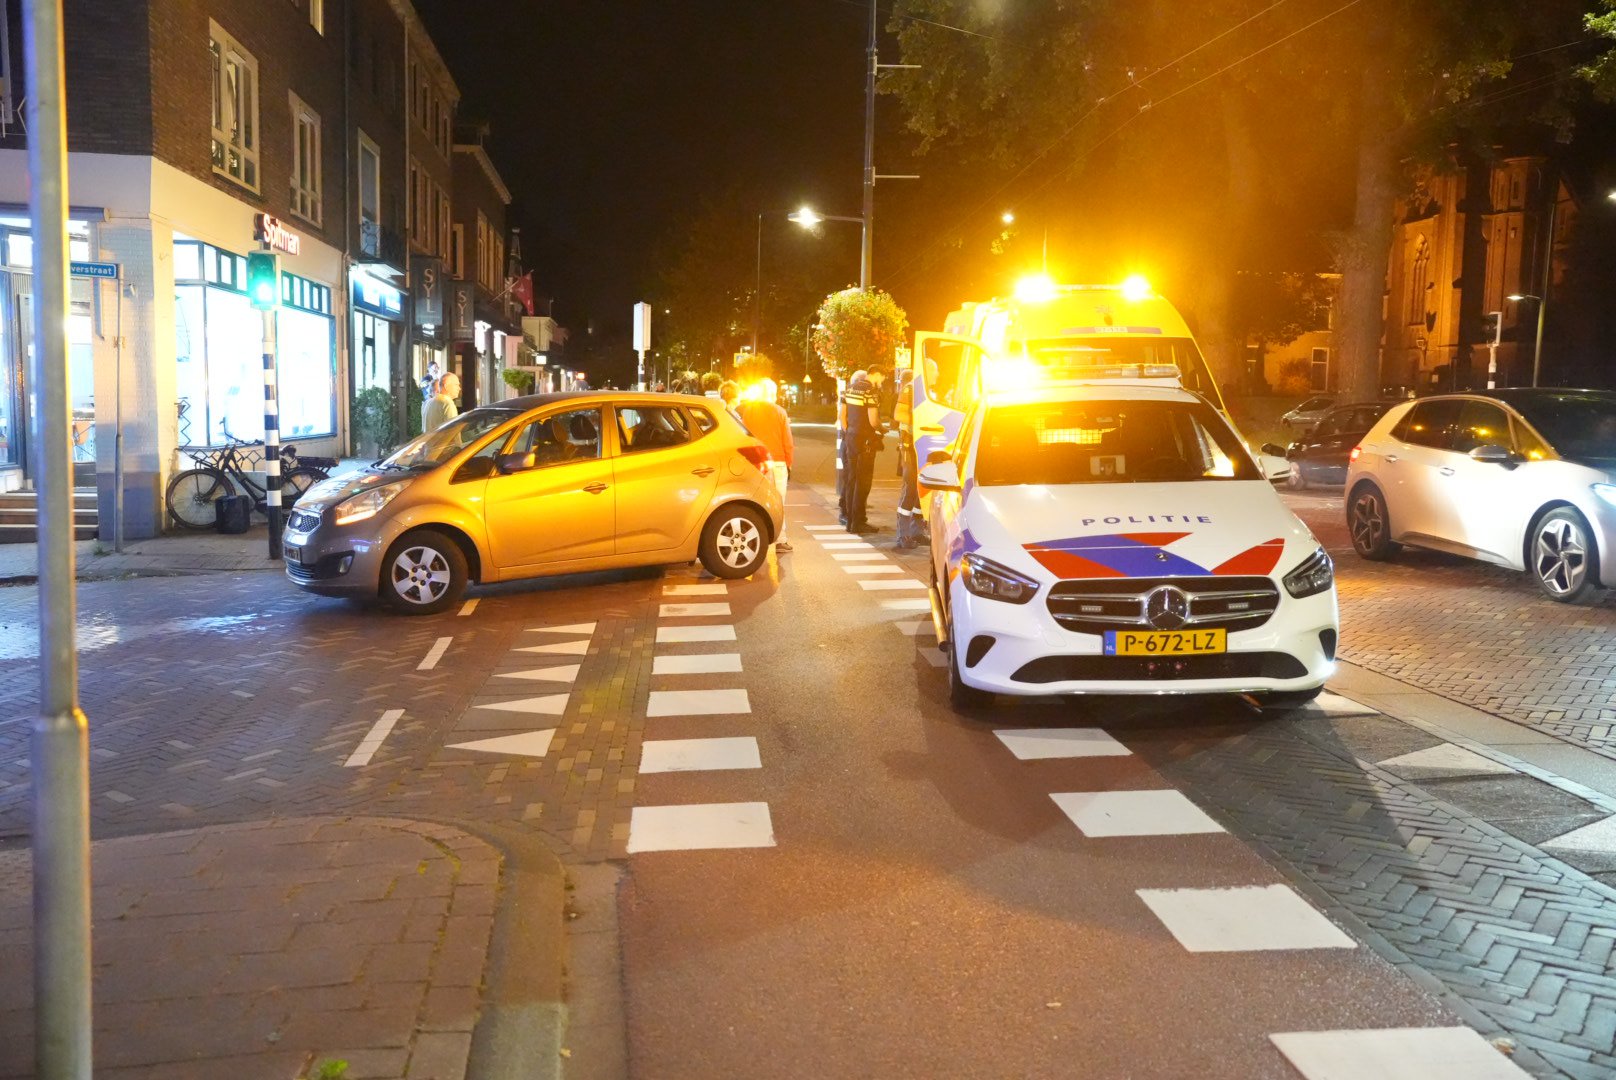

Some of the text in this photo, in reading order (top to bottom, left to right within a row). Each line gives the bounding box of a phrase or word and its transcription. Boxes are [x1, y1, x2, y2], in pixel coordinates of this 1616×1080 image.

[263, 213, 300, 257] Spitman
[70, 266, 113, 275] verstraat
[1081, 515, 1212, 526] POLITIE
[1124, 632, 1216, 652] P-672-LZ
